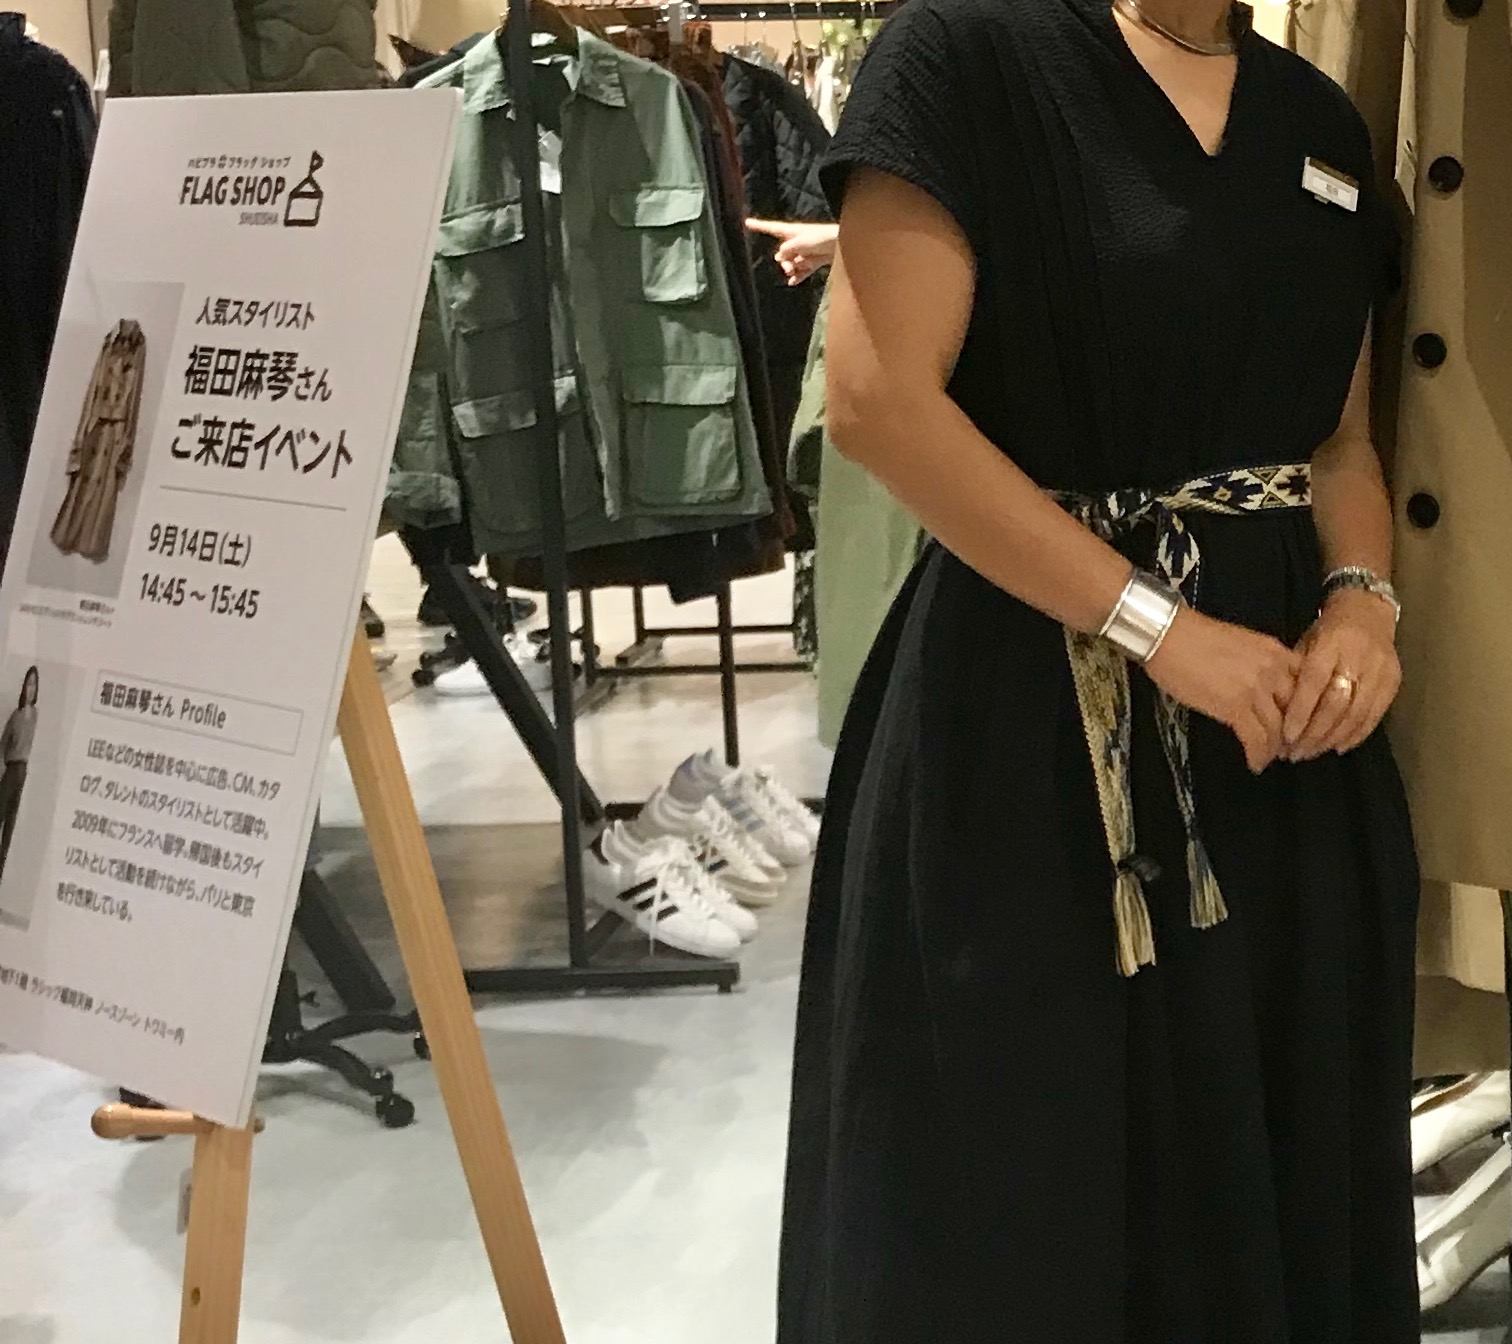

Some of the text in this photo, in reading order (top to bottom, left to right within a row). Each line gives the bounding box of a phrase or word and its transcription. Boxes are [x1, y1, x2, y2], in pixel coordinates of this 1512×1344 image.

[180, 176, 286, 206] FLAG SHOP
[196, 296, 315, 330] 人気スタイリスト
[184, 345, 332, 402] 福田麻琴さん
[171, 413, 353, 479] ご来店イベント
[180, 697, 227, 729] Profile
